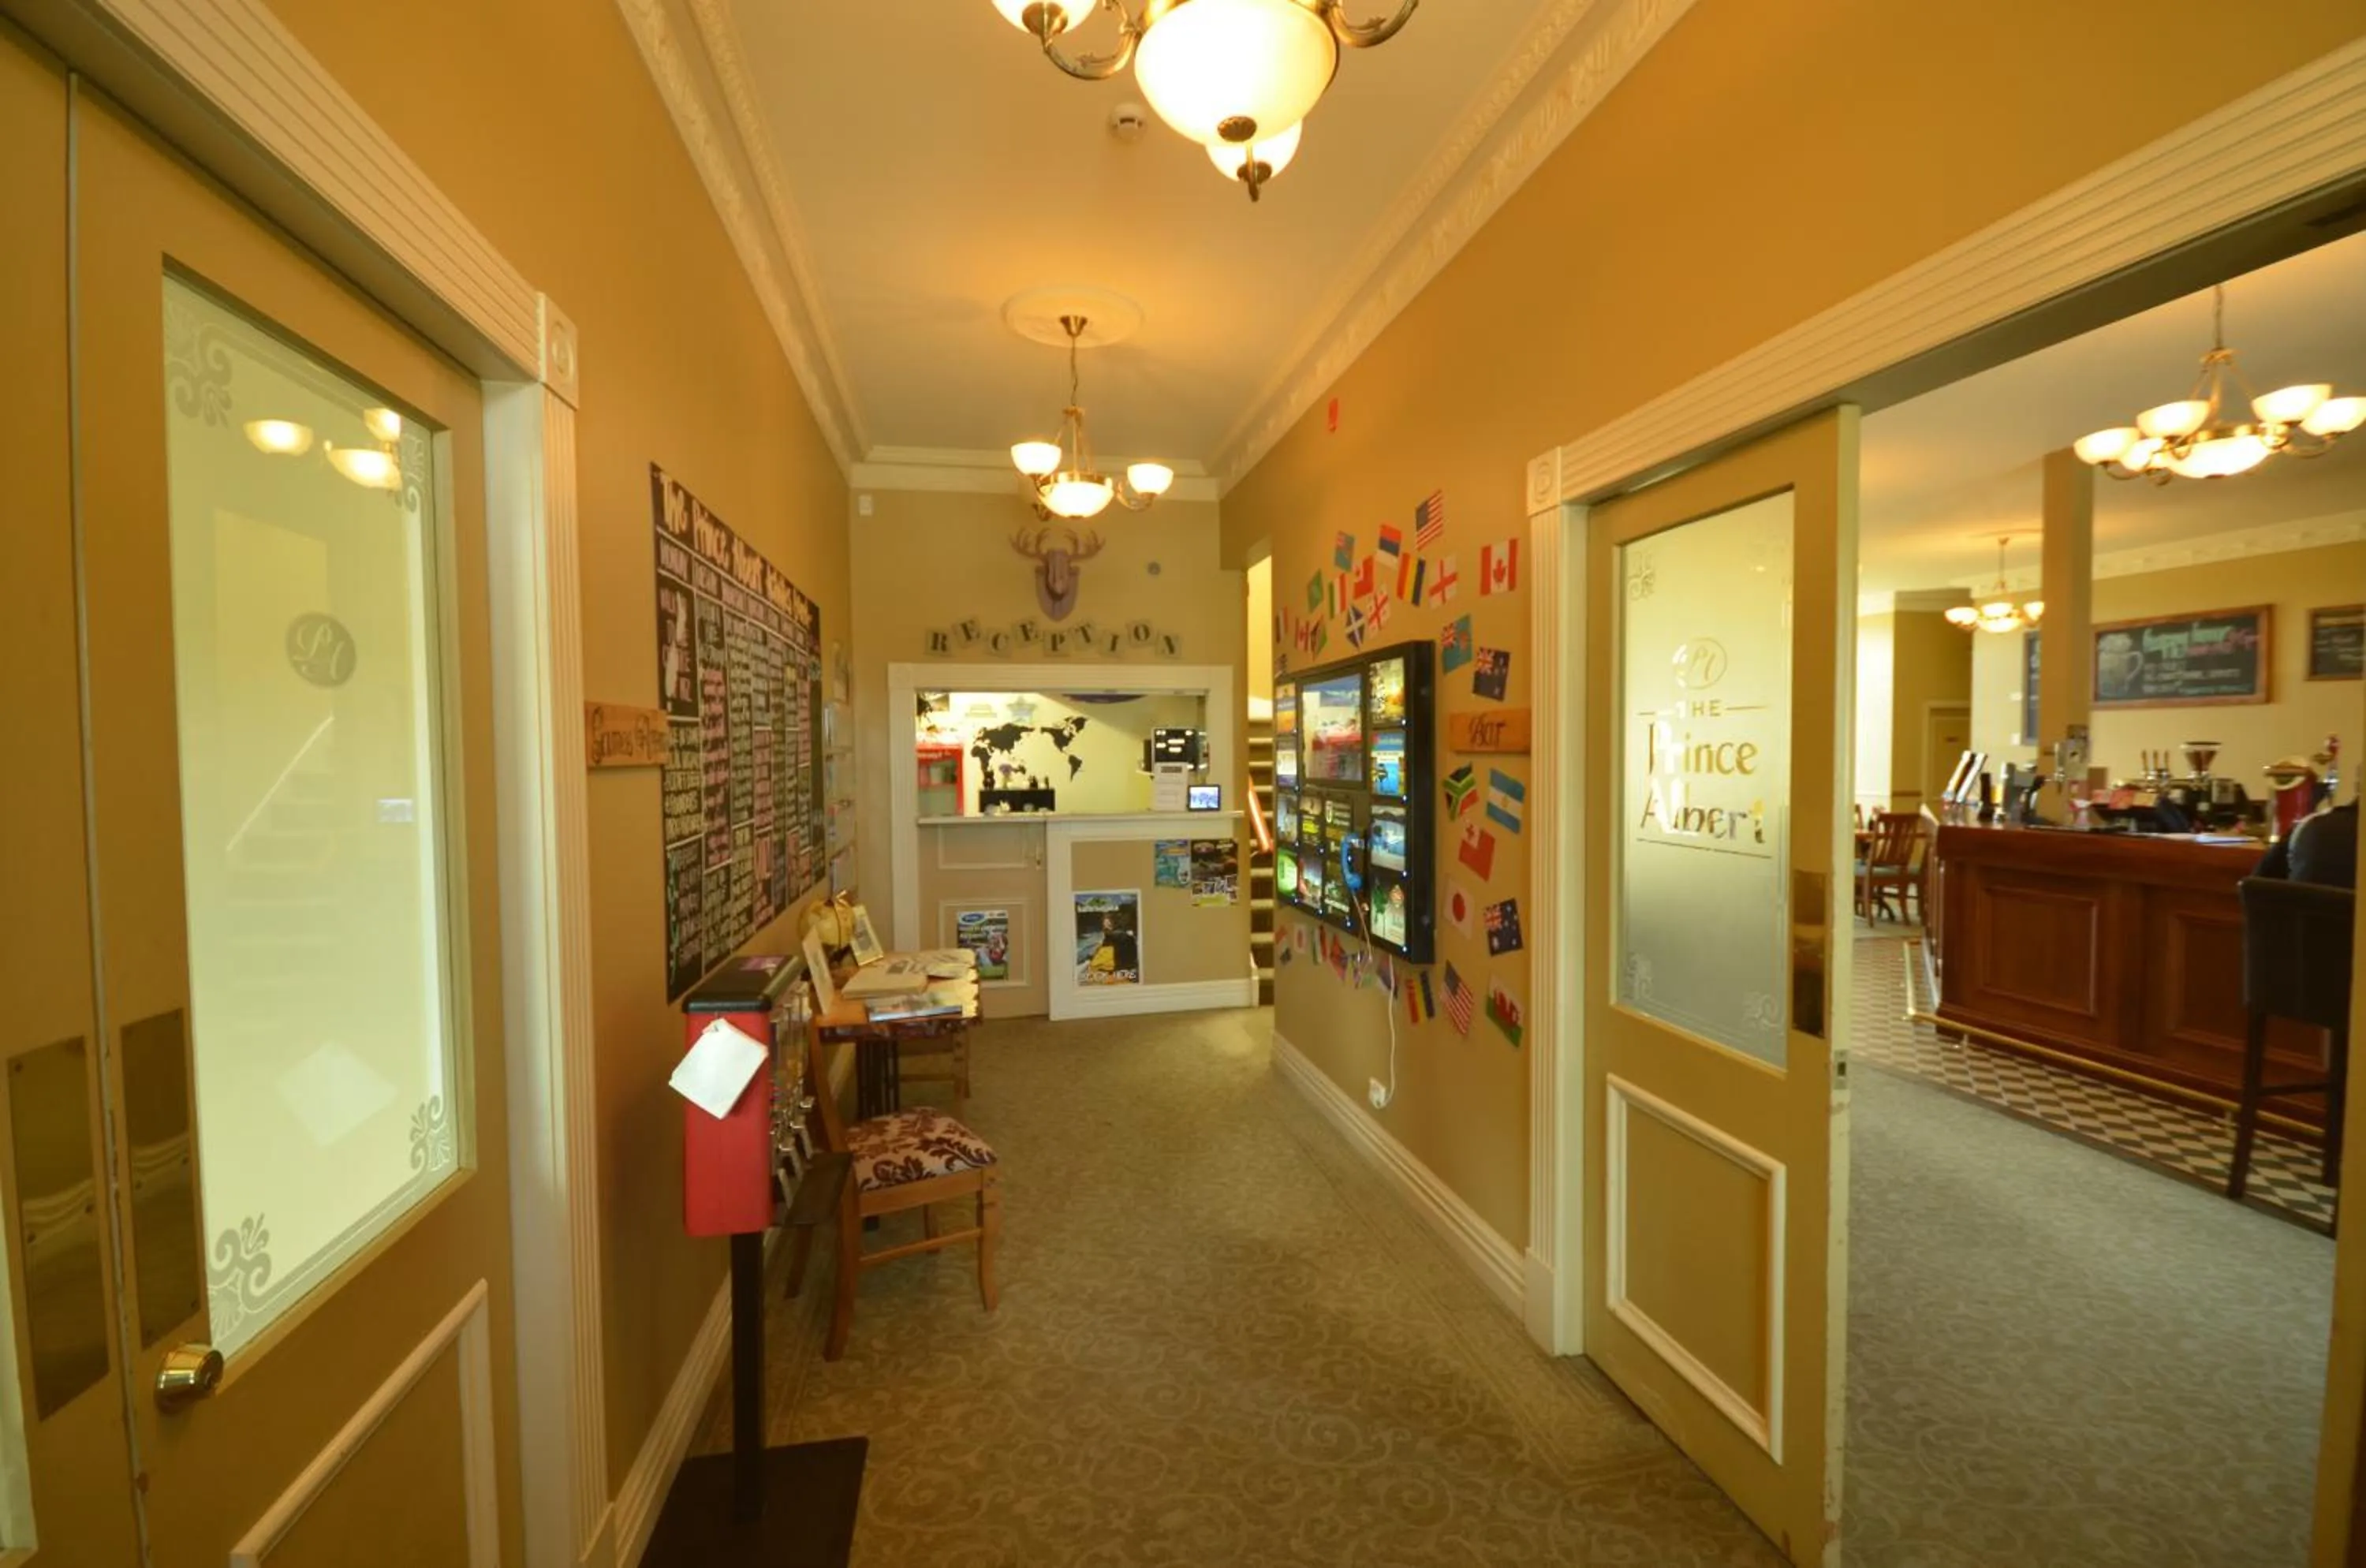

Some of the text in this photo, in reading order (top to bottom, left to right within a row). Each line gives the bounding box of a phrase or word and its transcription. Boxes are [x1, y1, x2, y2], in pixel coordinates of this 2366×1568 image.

[660, 472, 688, 535] The
[930, 619, 1177, 655] RECEPTION
[1674, 699, 1722, 718] THE
[1648, 719, 1759, 775] Prince
